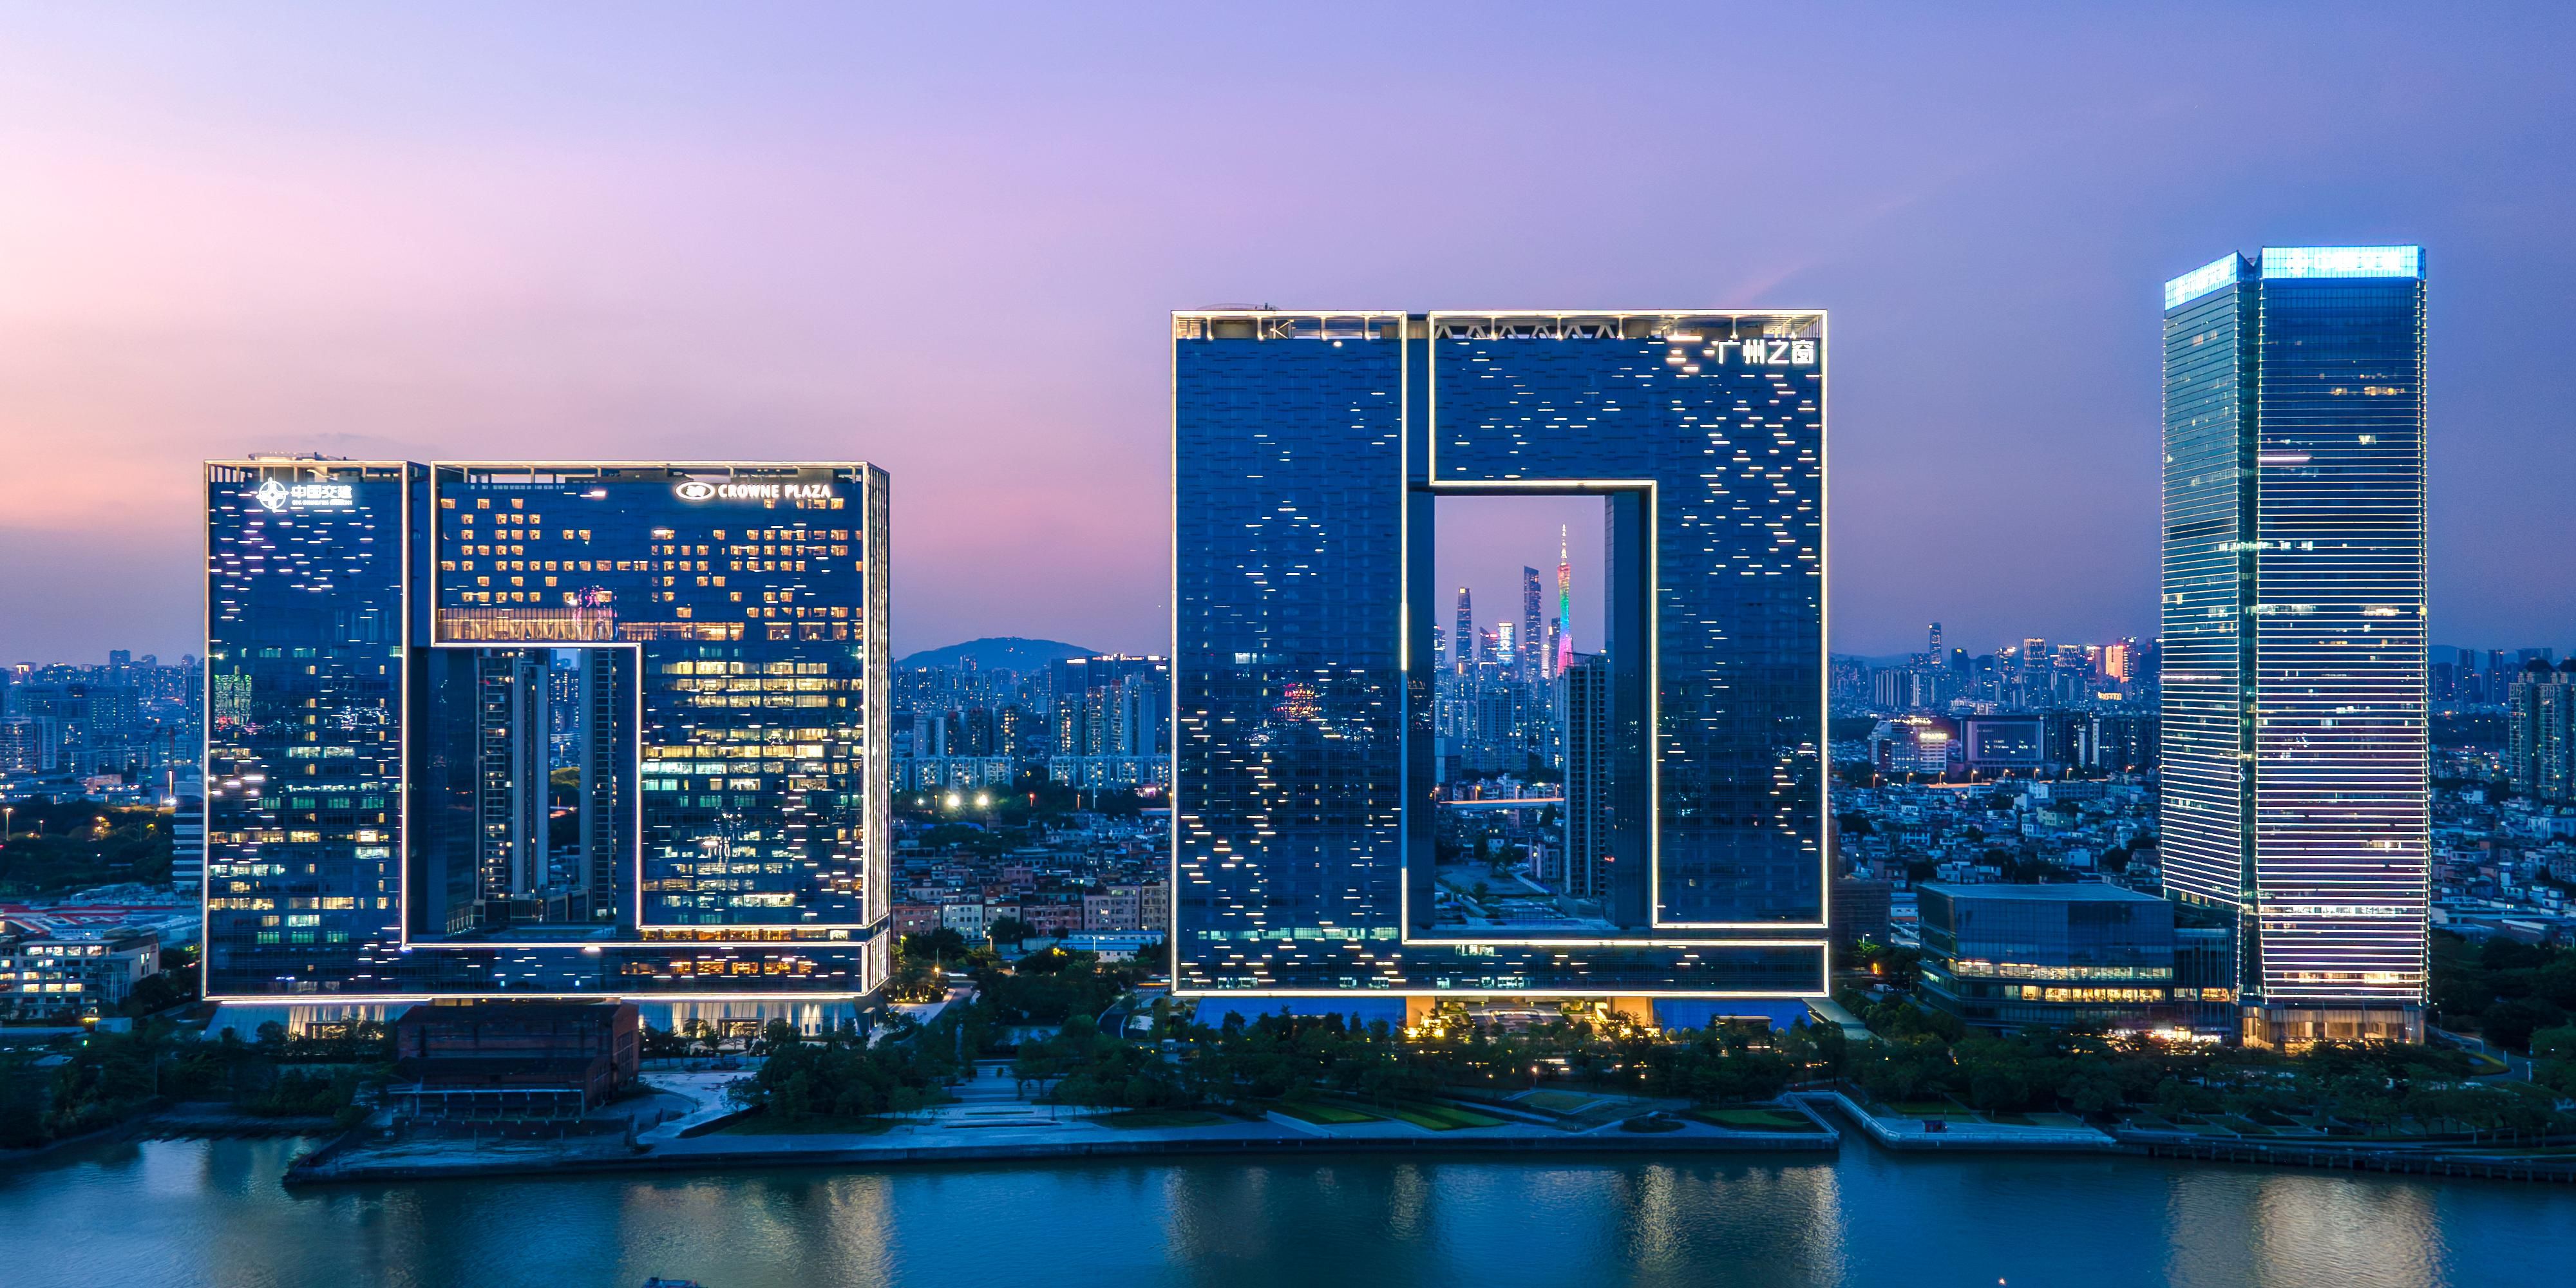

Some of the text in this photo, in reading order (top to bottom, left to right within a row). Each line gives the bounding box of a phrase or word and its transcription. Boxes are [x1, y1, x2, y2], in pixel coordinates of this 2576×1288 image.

[1718, 339, 1814, 364] 广州之窗
[291, 484, 352, 499] 中国交建
[717, 484, 831, 498] CROWNE PLAZA
